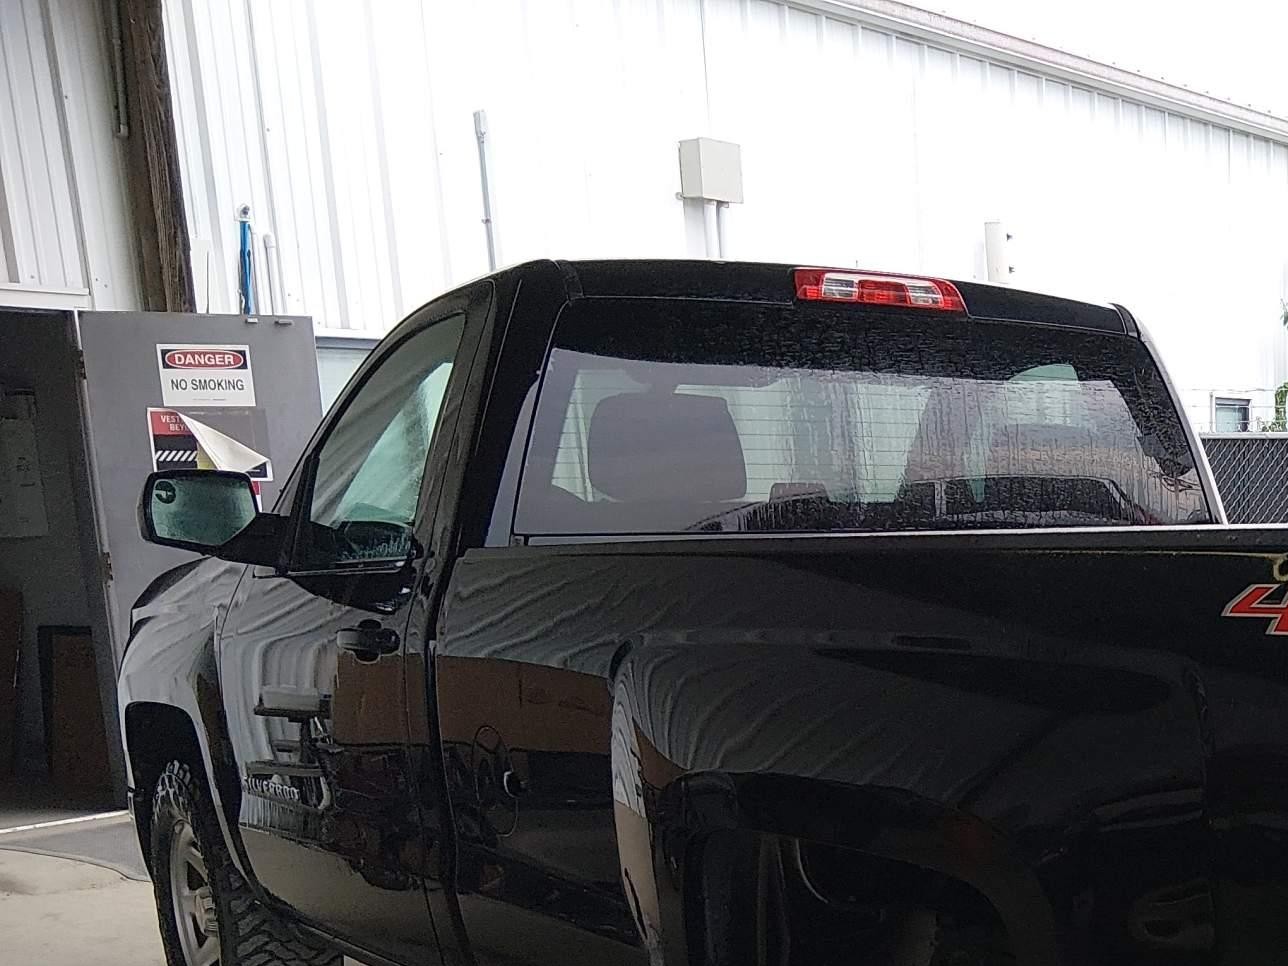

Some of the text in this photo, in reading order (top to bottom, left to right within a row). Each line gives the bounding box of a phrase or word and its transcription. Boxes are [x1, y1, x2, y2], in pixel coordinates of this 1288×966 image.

[174, 353, 235, 366] DANGER
[171, 379, 245, 391] NO SMOKING
